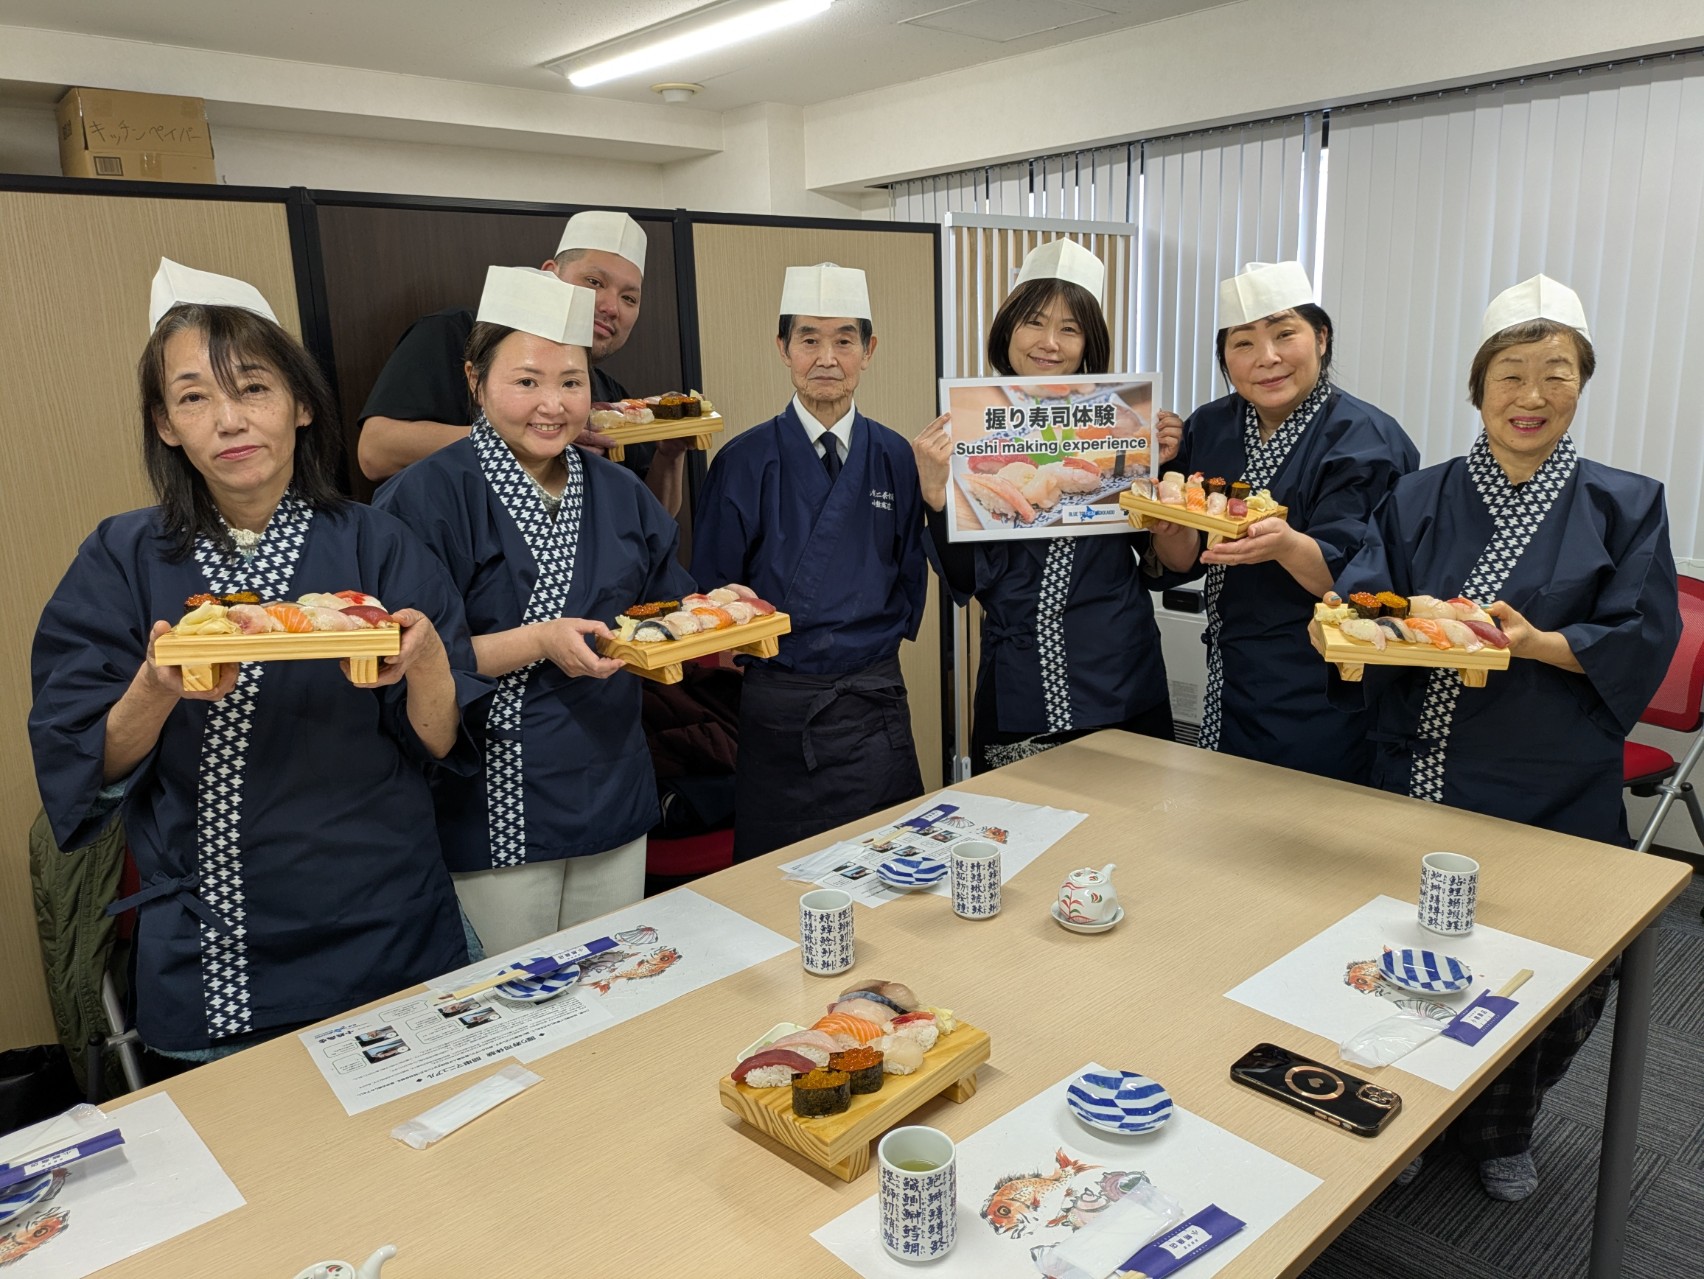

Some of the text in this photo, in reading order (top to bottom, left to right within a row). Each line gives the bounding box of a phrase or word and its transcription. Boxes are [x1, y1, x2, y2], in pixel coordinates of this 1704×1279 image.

[89, 119, 202, 146] キッチンペイパー
[985, 404, 1116, 430] 握り寿司体験
[956, 437, 1147, 456] Sushi making experience
